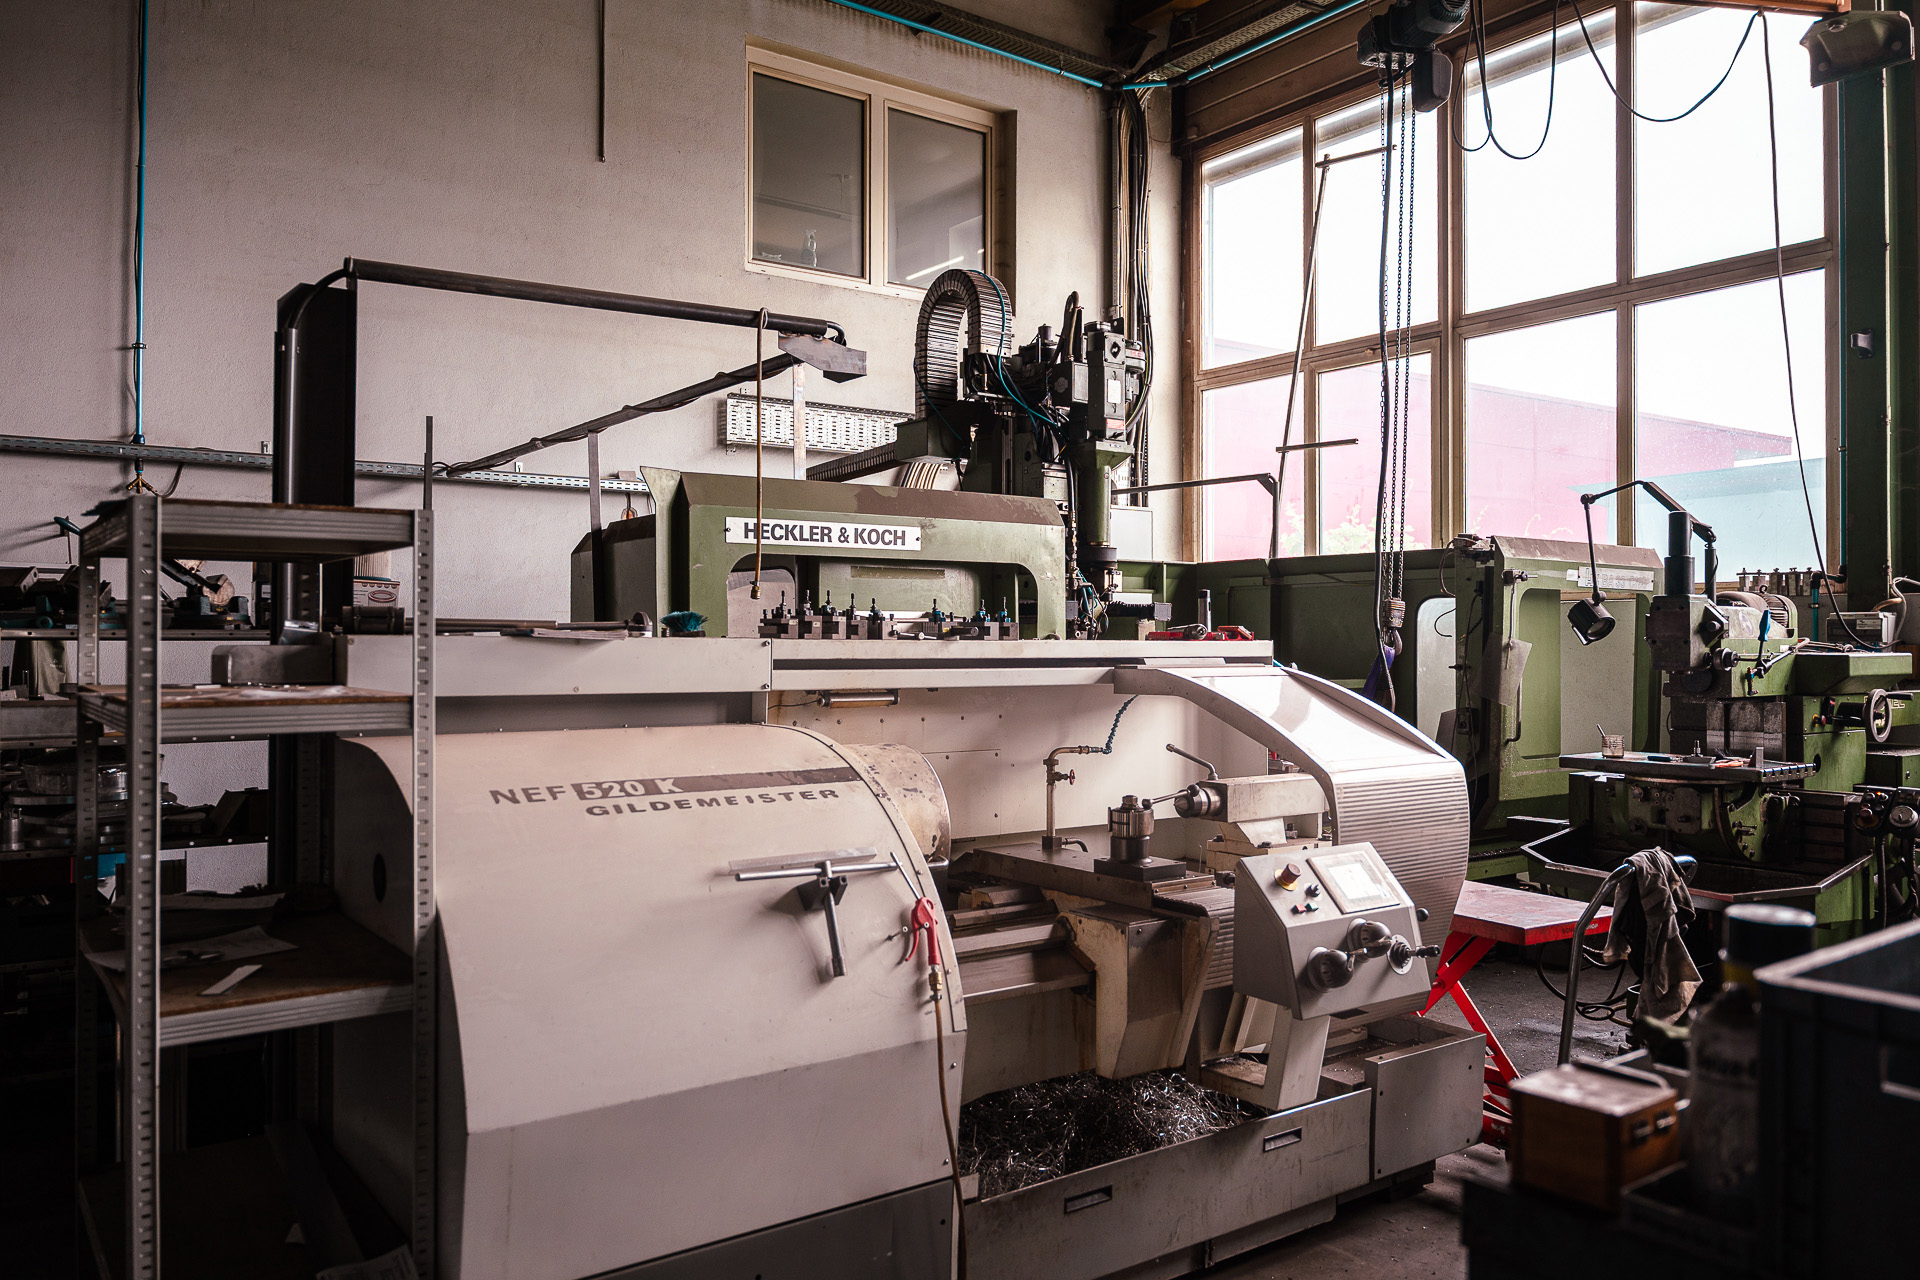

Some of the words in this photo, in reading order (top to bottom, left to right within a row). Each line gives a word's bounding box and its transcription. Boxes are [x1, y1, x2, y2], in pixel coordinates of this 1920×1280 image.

[743, 521, 833, 544] HECKLER
[838, 526, 850, 544] &
[853, 527, 906, 546] KOCH
[489, 785, 567, 804] NEF
[581, 780, 646, 800] 520
[654, 778, 685, 794] K
[585, 789, 839, 816] GILDEMEISTER
